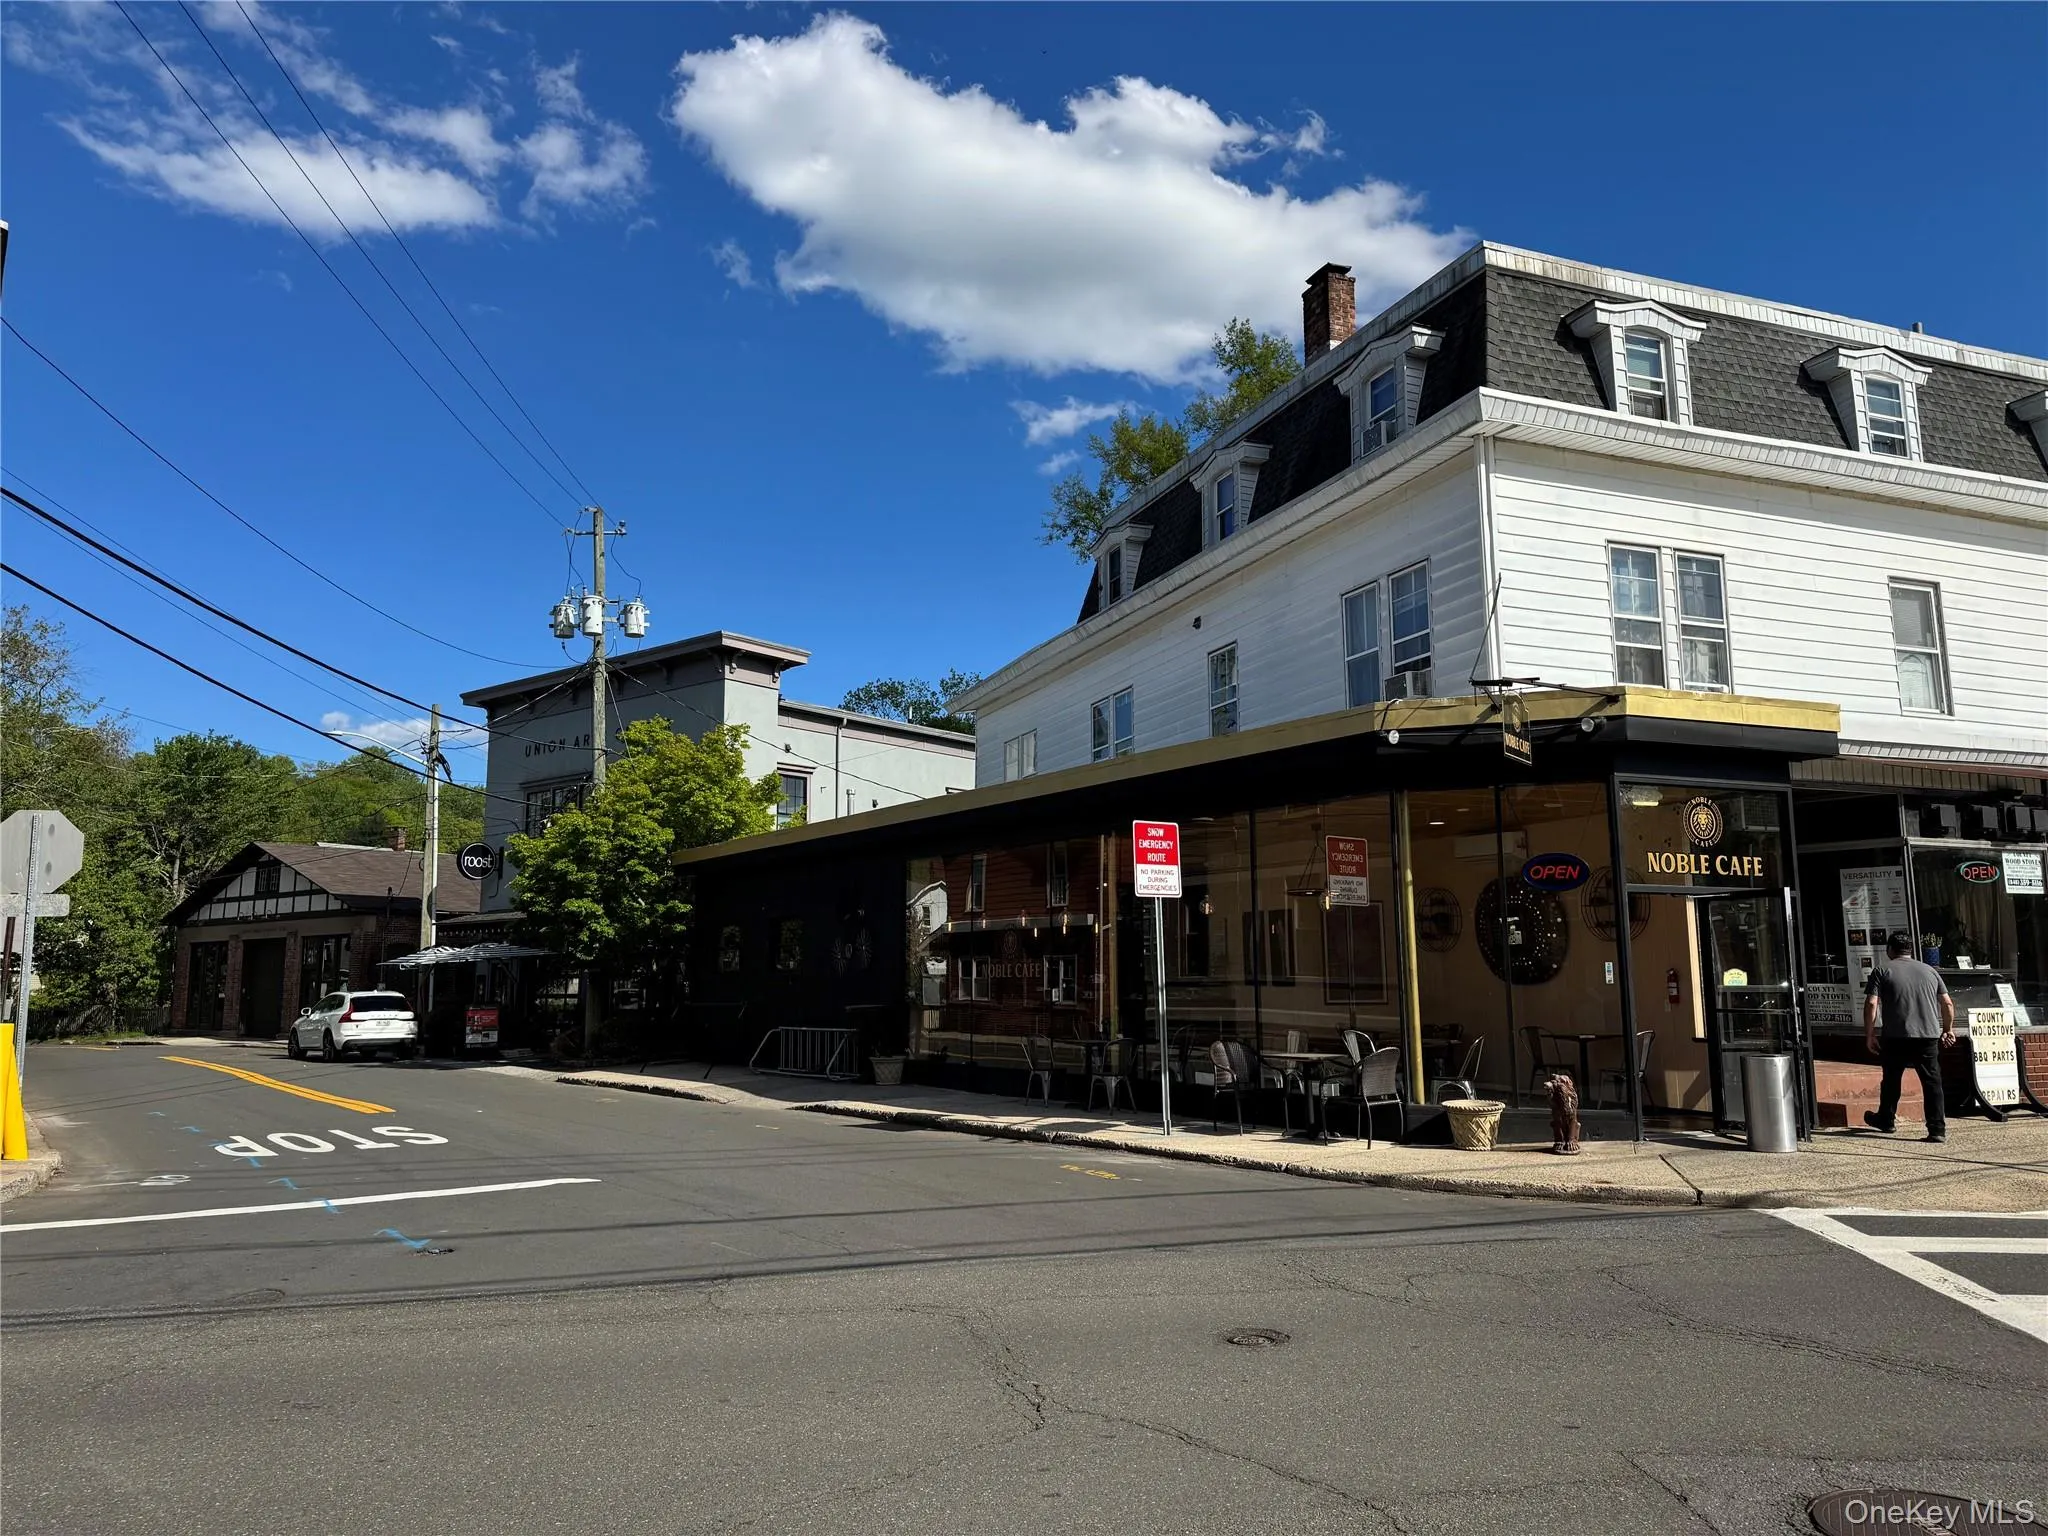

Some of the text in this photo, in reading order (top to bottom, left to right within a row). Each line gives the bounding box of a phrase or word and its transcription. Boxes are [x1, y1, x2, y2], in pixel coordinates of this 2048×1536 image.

[525, 737, 566, 758] UNION
[1690, 796, 1712, 806] NOBLE
[1147, 827, 1165, 837] SNOW
[1138, 839, 1174, 850] EMERGENCY
[1694, 839, 1714, 848] CAFE
[464, 854, 493, 868] roost
[1147, 852, 1167, 863] ROUTE
[1647, 852, 1764, 877] NOBLE CAFE
[1530, 865, 1580, 879] OPEN
[1842, 870, 1893, 880] VERSATILITY
[1963, 866, 1996, 880] OPEN
[1138, 884, 1178, 892] EMERGENCIES
[982, 962, 1041, 978] NOBLE CAFE
[1976, 1012, 2004, 1023] COUNTY
[1971, 1025, 2014, 1037] WOODSTOVE
[1974, 1050, 2015, 1063] BBQ PARTS
[214, 1126, 449, 1157] STOP
